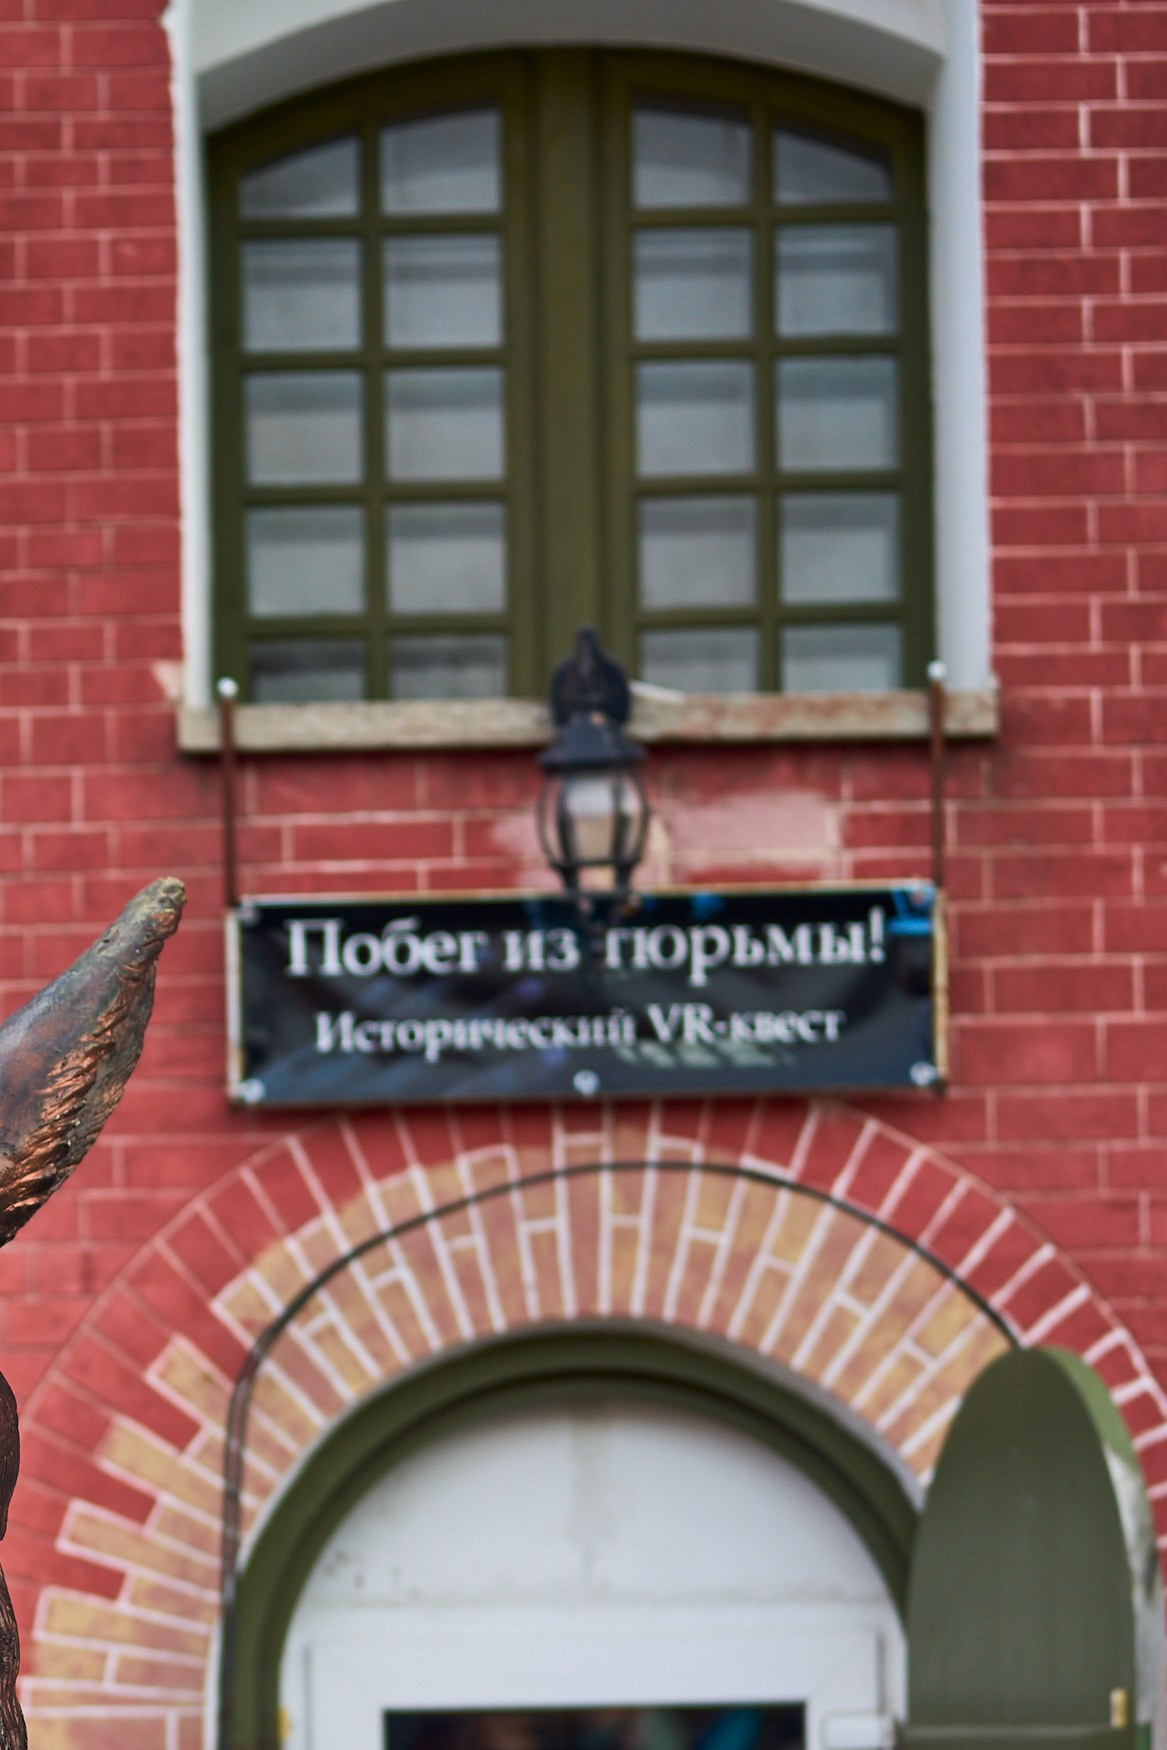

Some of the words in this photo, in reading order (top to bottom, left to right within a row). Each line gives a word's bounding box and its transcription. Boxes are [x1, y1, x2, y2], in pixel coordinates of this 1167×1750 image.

[285, 914, 488, 977] Побег
[501, 927, 581, 973] из
[315, 1004, 635, 1063] Исторический
[646, 1001, 847, 1044] VR-квест
